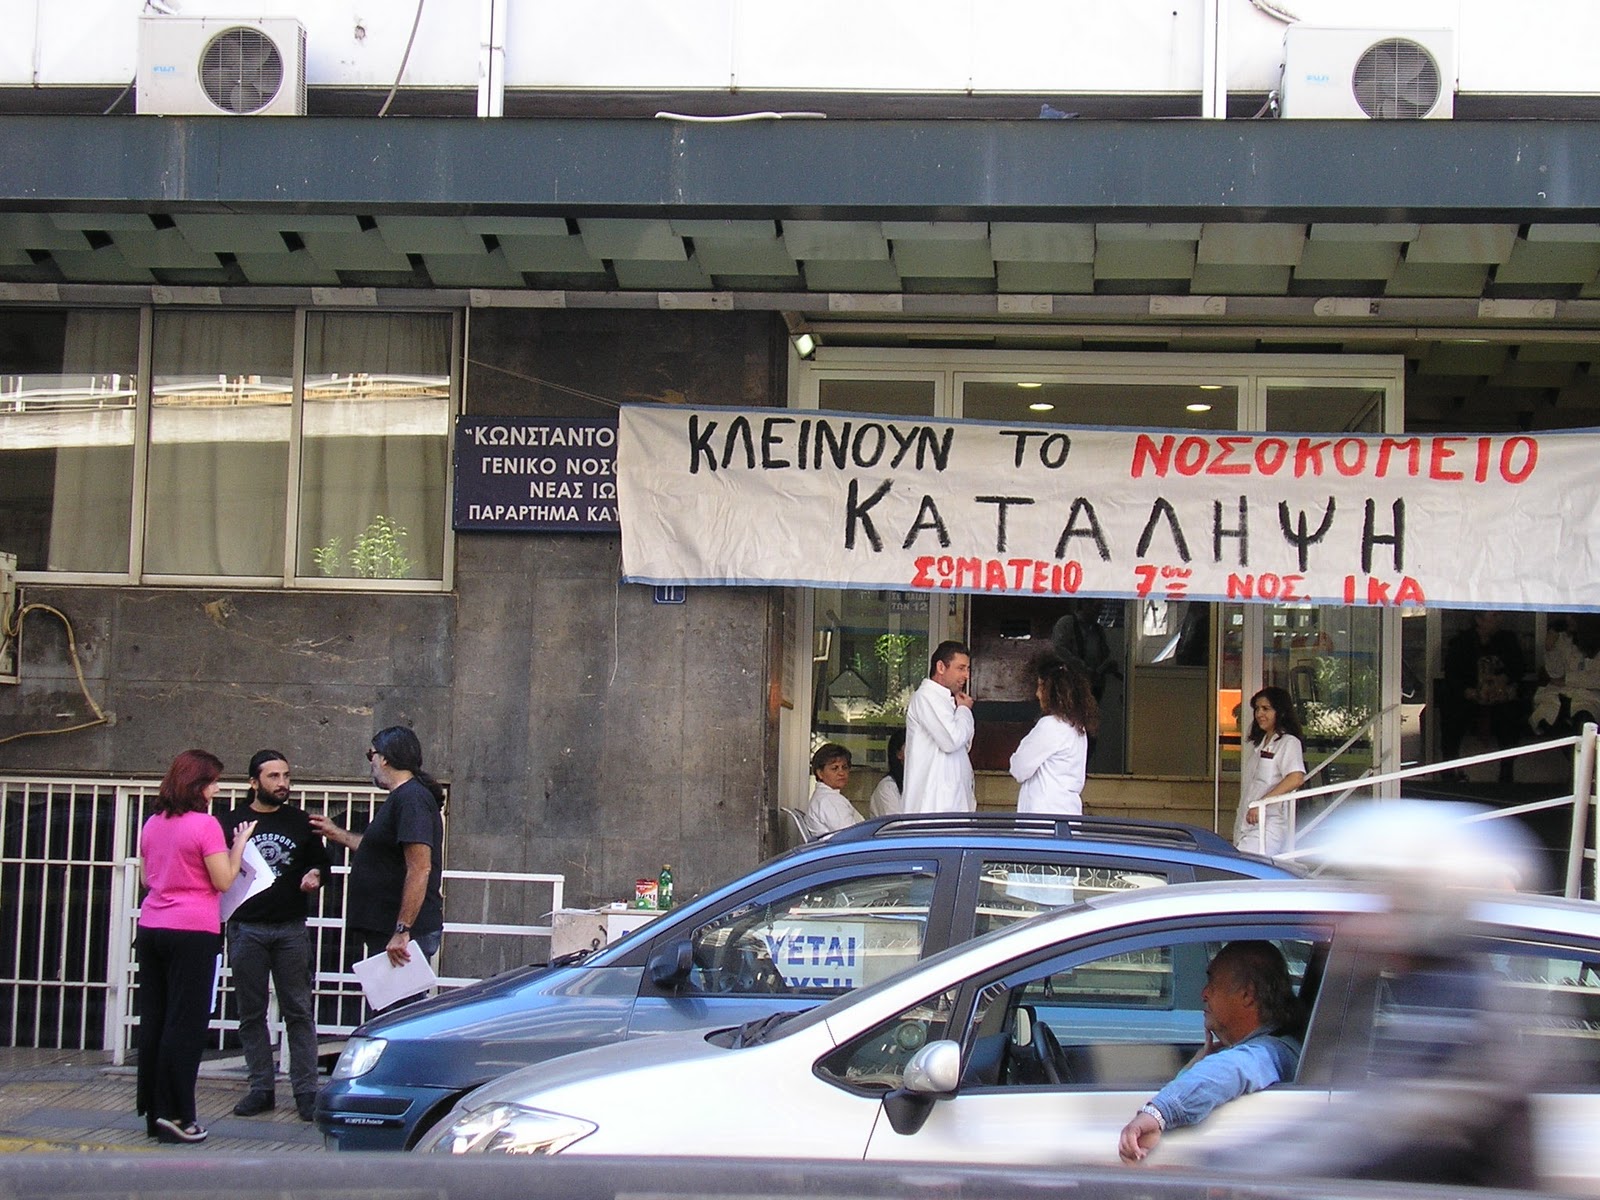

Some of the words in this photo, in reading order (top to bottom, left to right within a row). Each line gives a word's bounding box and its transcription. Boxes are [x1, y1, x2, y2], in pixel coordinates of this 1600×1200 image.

[465, 426, 619, 447] “ΚΩΝΣΤΑΝΤΟ
[688, 414, 955, 474] ΚΛΕΙΝΟΥΝ
[999, 431, 1072, 469] ΤΟ
[1130, 433, 1539, 485] ΝΟΣΟΚΟΜΕΙΟ
[482, 457, 557, 475] ΓΕΝΙΚΟ
[530, 482, 583, 499] ΝΕΑΣ
[469, 505, 579, 521] ΠΑΡΑΡΤΗΜΑ
[845, 478, 1406, 574] ΚΑΤΑΛΗΨΗ
[911, 556, 1083, 595] ΣΩΜΑΤΕΙΟ
[1344, 575, 1426, 606] ΙΚΑ
